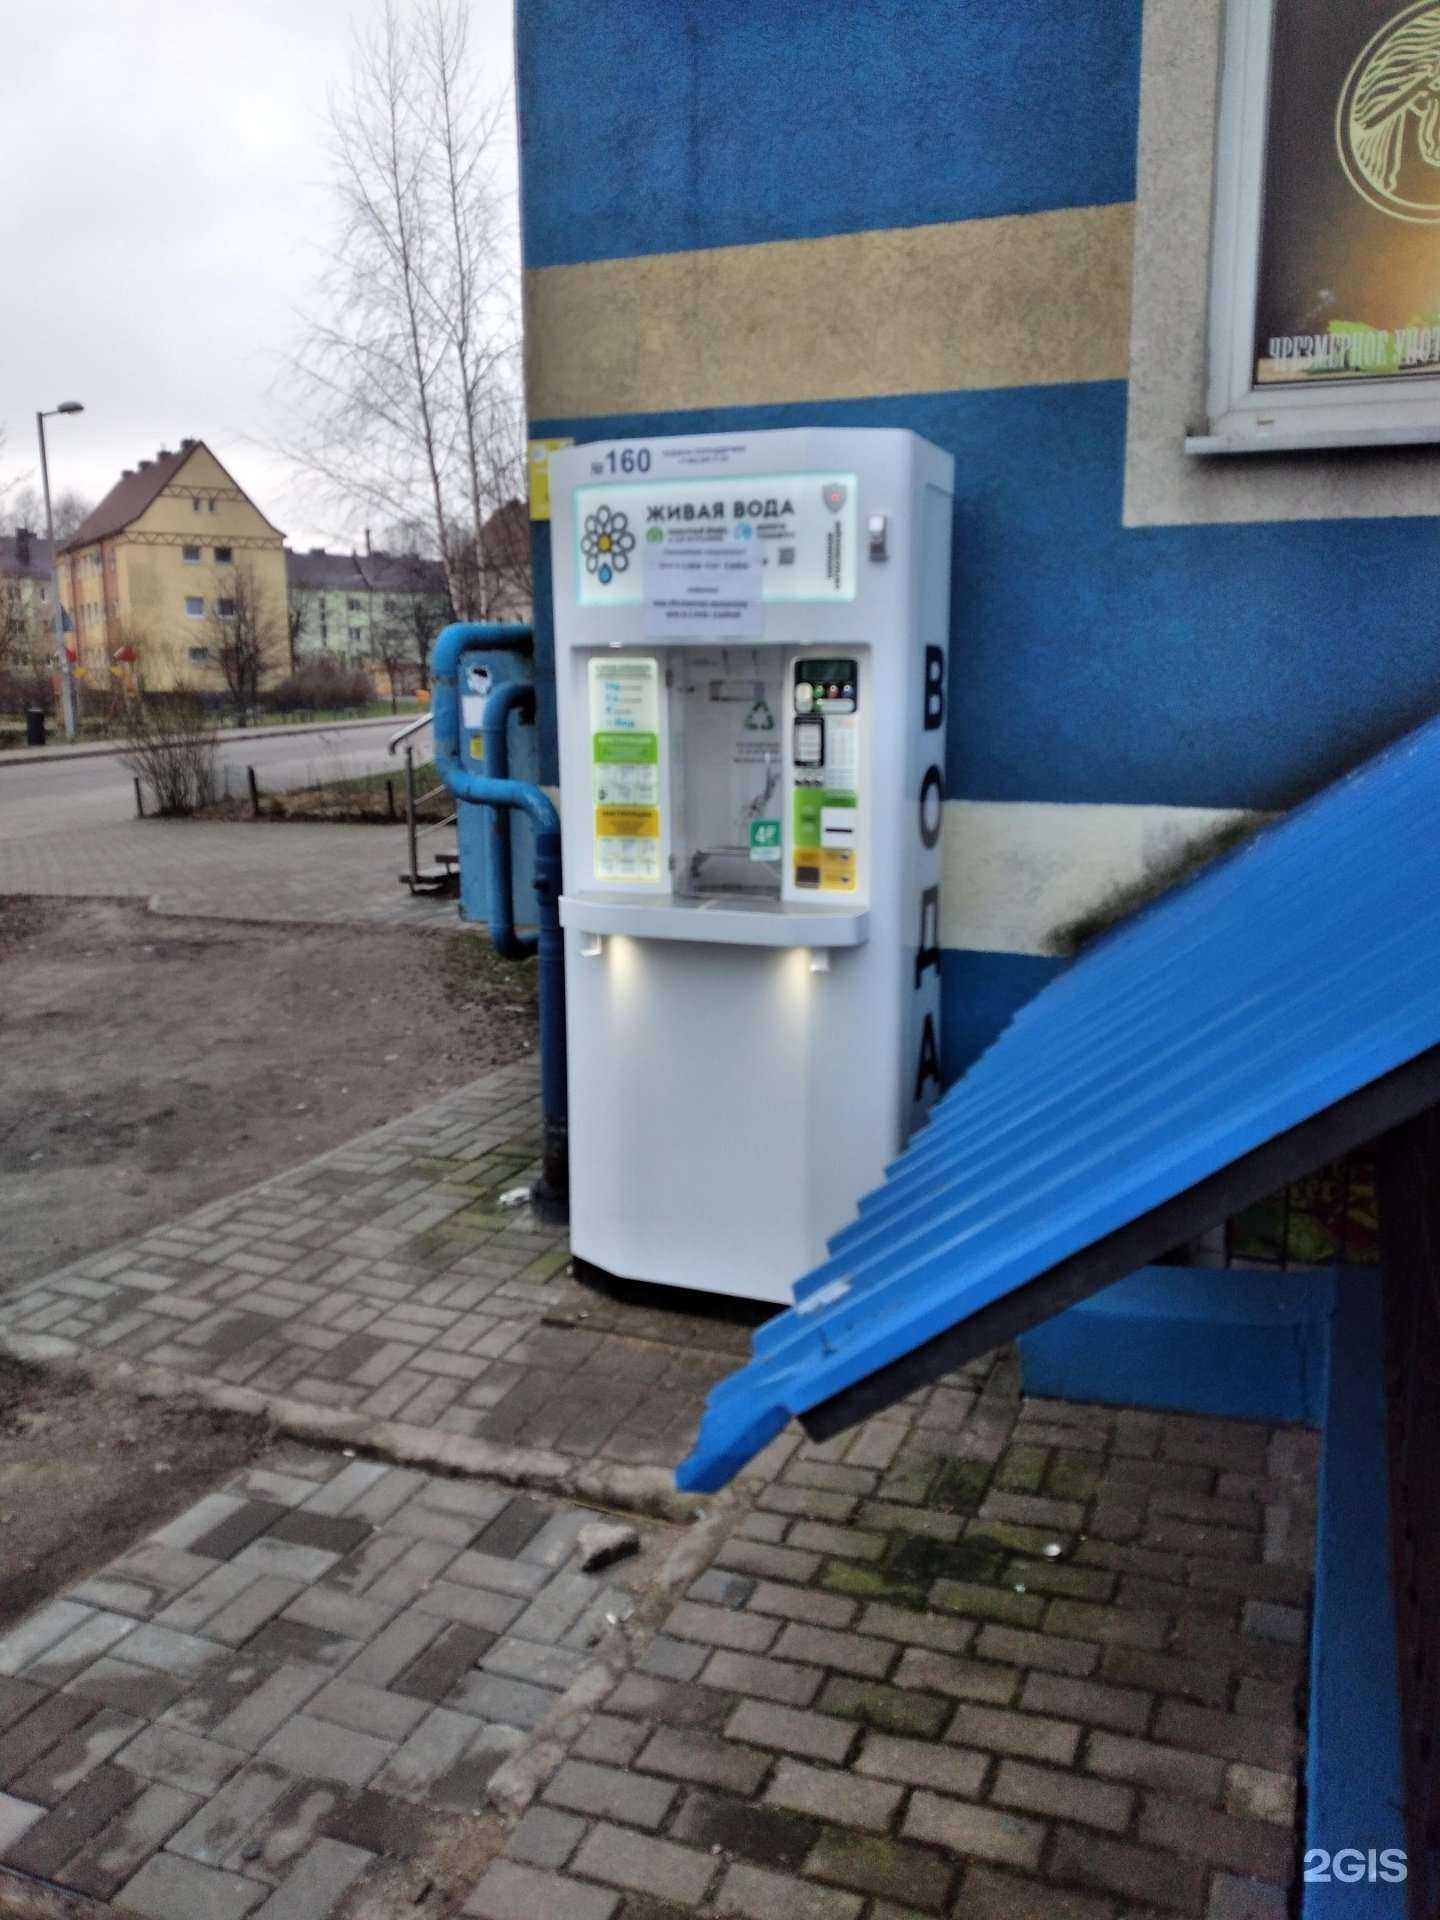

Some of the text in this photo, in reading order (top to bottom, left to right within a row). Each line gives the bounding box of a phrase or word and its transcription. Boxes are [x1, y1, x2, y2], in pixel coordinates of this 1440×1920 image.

[647, 498, 796, 521] ЖИВАЯ ВОДА
[914, 644, 944, 1103] ВОДА
